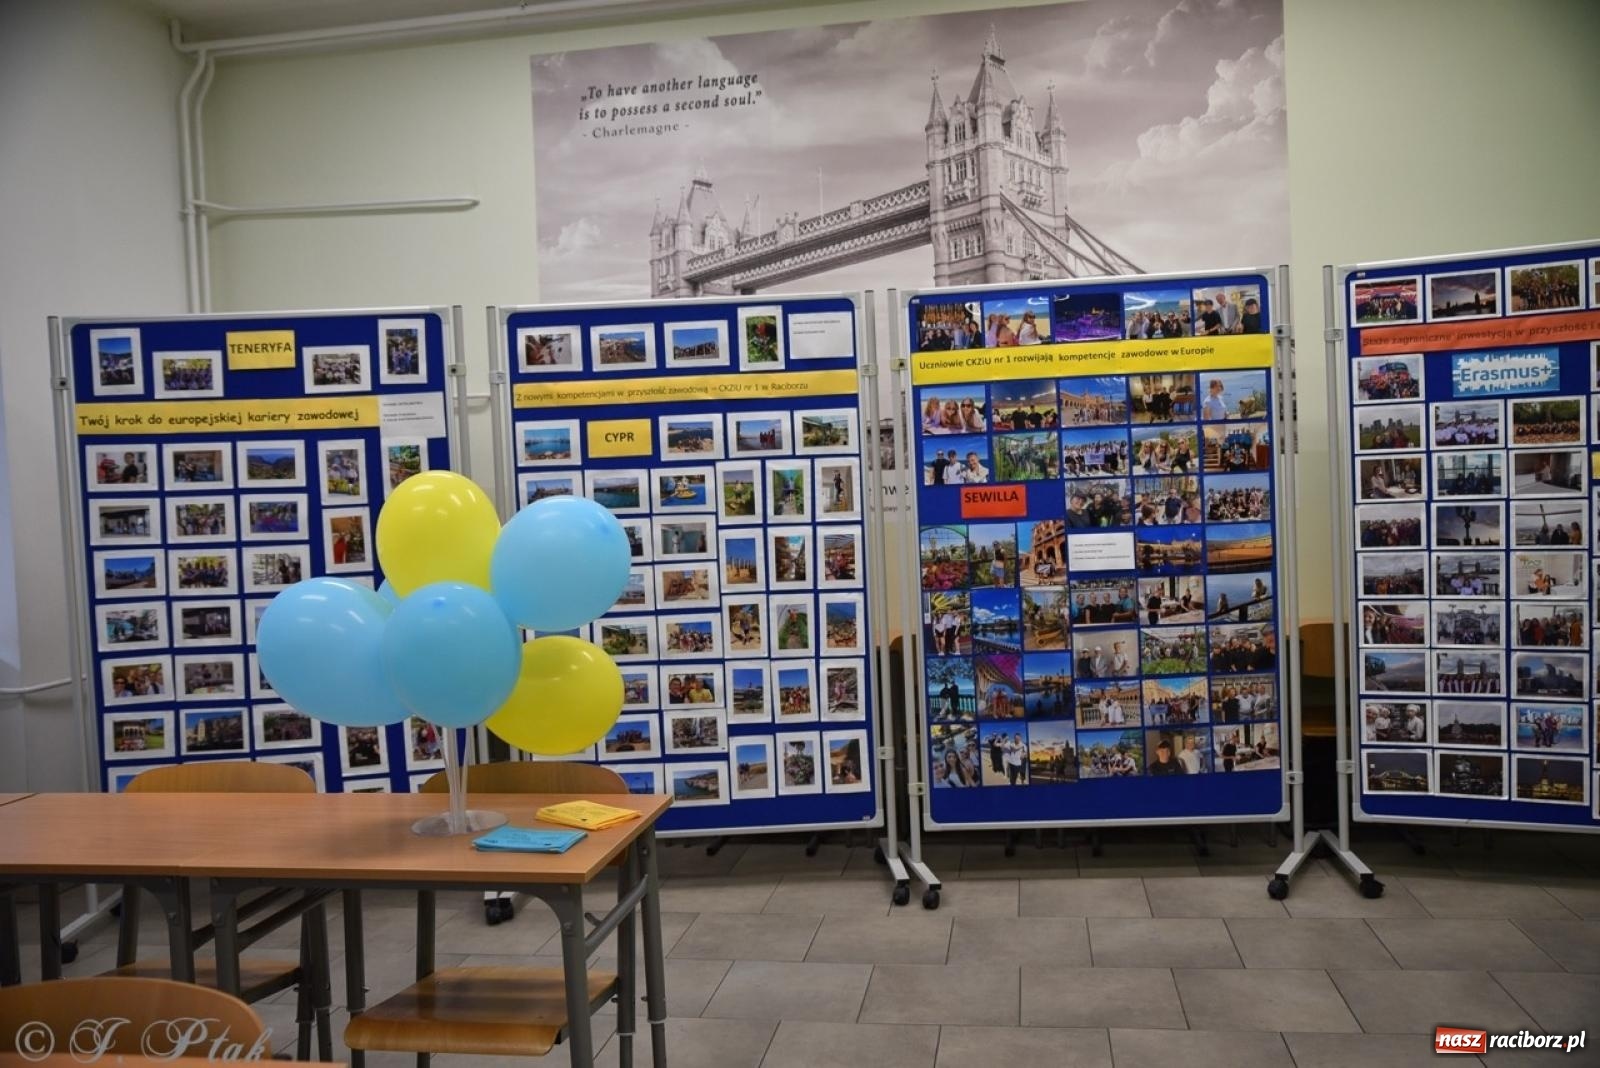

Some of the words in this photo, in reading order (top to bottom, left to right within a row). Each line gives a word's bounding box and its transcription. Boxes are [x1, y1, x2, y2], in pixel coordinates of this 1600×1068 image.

[607, 83, 638, 97] have
[642, 78, 694, 93] another
[698, 73, 758, 91] language
[579, 108, 590, 120] is
[594, 107, 607, 119] to
[610, 103, 658, 121] possess
[663, 103, 671, 112] a
[675, 95, 719, 111] second
[592, 122, 680, 139] Charlemagne
[229, 342, 292, 354] TENERYFA
[919, 358, 963, 370] Uczniowie
[965, 357, 992, 367] CKZiU
[1006, 355, 1011, 363] 1
[1013, 353, 1053, 364] rozwijają
[1058, 350, 1116, 362] kompetencje
[1121, 349, 1168, 358] zawodowe
[1171, 348, 1179, 356] w
[1180, 346, 1214, 357] Europie
[1460, 365, 1551, 382] Erasmus+
[80, 415, 110, 429] Twój
[115, 415, 142, 425] krok
[148, 414, 162, 425] do
[169, 411, 242, 426] europejskiej
[248, 411, 290, 424] kariery
[297, 408, 359, 421] zawodowej
[604, 432, 635, 443] CYPR
[964, 490, 1019, 503] SEWILLA
